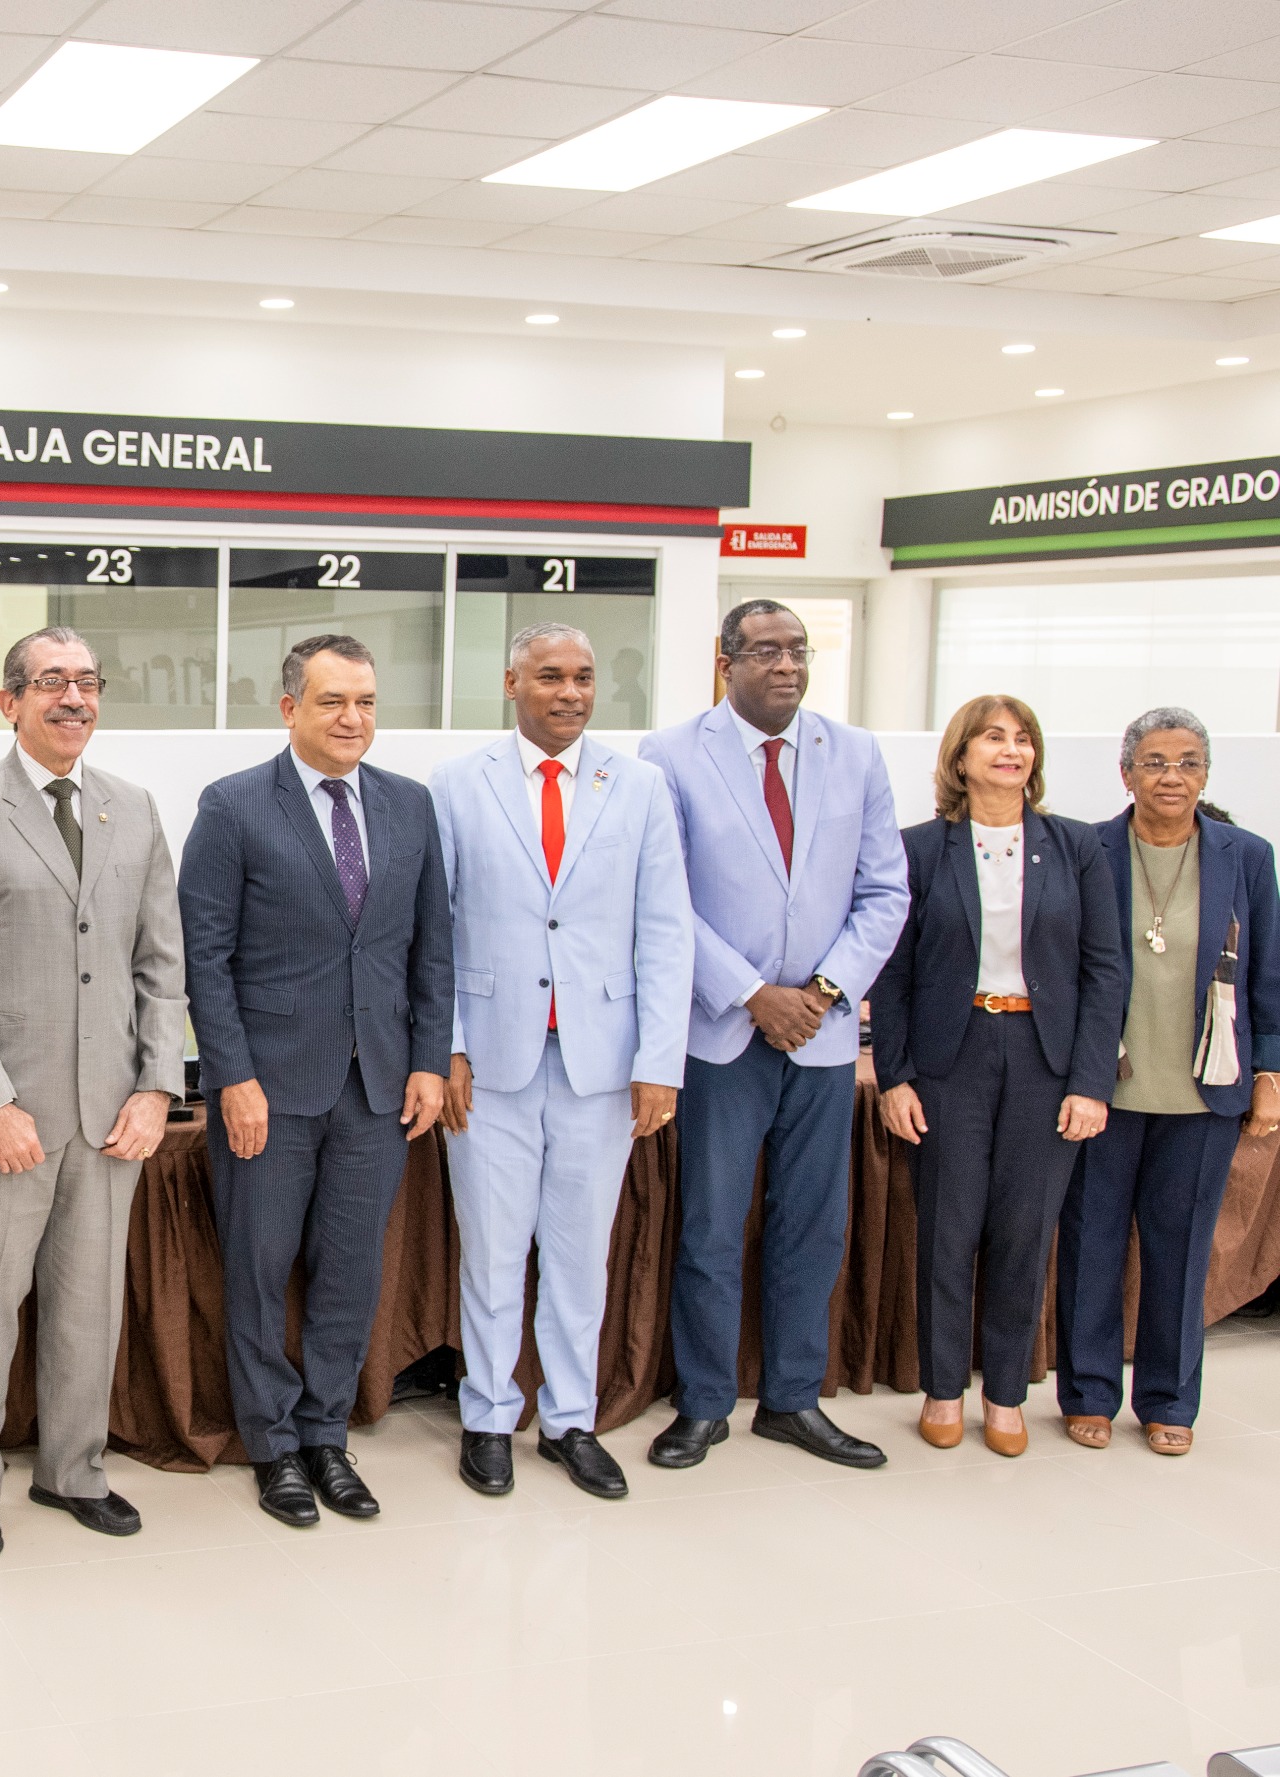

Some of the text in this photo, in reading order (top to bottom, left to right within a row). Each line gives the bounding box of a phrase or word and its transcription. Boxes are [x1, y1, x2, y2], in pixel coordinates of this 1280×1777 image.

[82, 430, 273, 473] GENERAL
[989, 469, 1280, 525] ADMISIÓN DE GRADO
[747, 540, 798, 551] EMERGENCIA
[753, 532, 793, 541] SALIDA DE
[86, 548, 132, 583] 23
[317, 553, 361, 588] 22
[543, 558, 576, 592] 21
